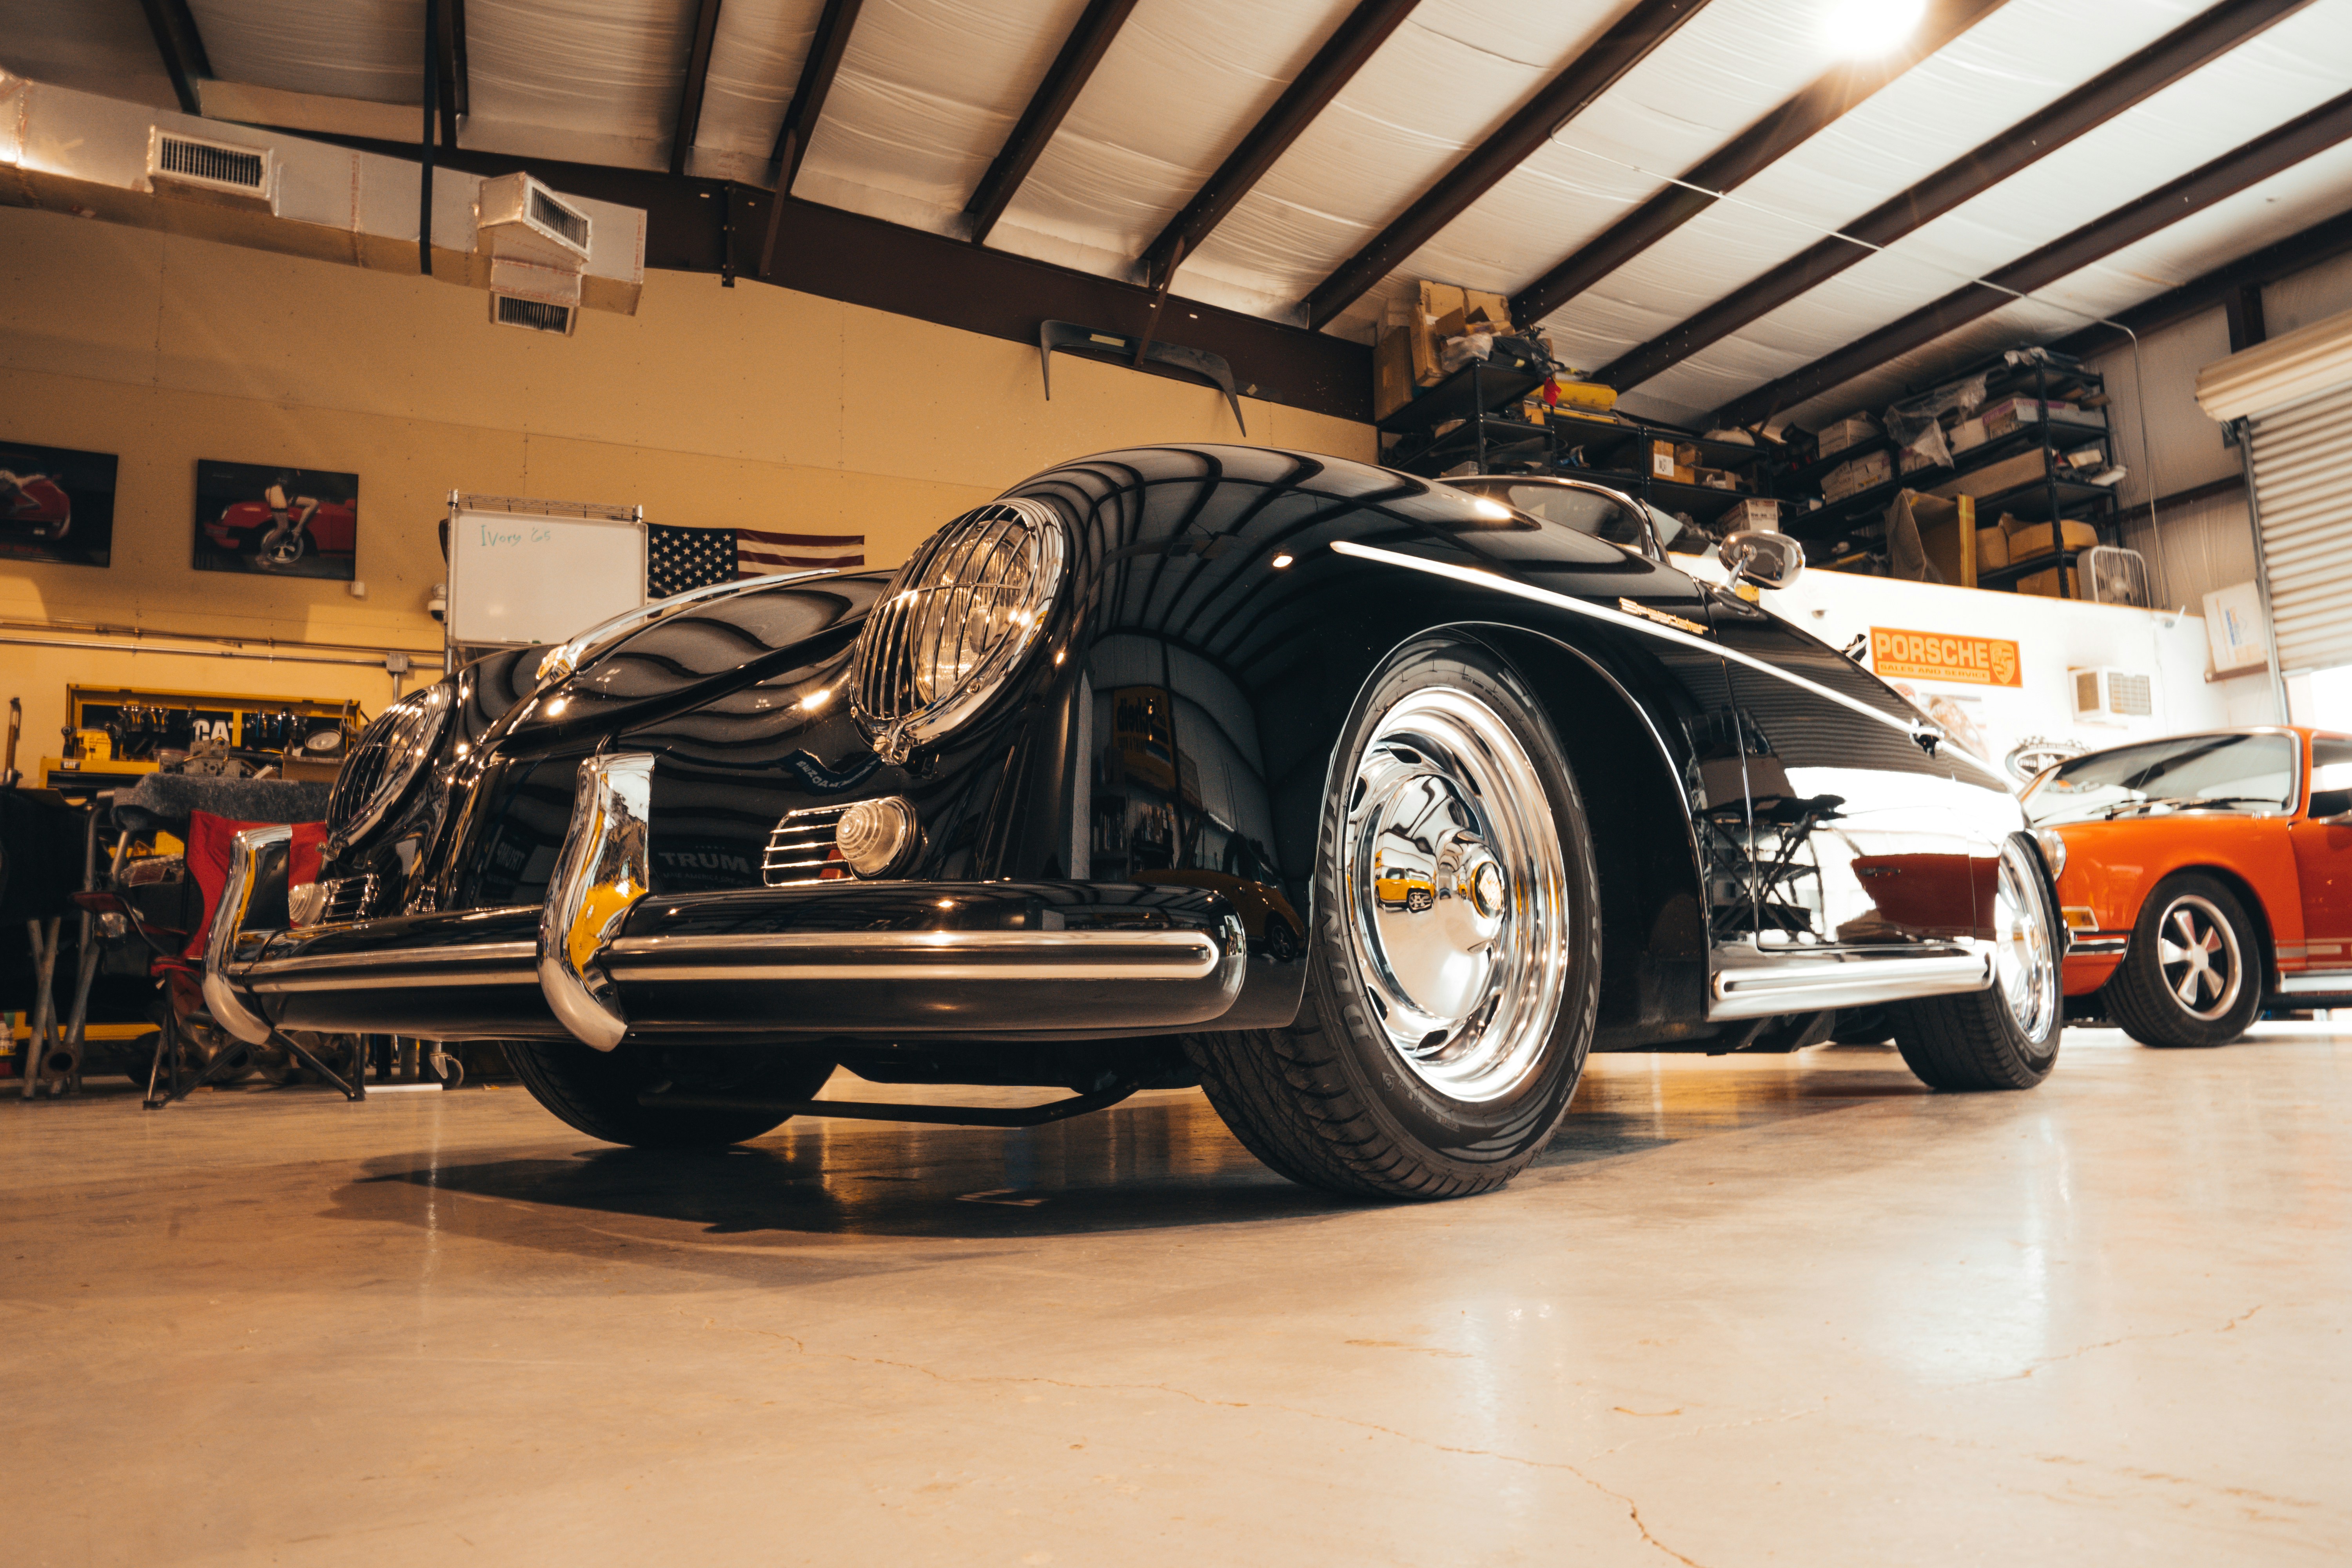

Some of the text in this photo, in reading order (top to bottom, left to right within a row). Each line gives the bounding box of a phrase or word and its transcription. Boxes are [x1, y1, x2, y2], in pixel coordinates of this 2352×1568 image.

[481, 524, 521, 546] Ivory
[1875, 632, 1989, 669] PORSCHE
[1880, 664, 1914, 672] SALES
[1944, 671, 1988, 679] SERVICE
[192, 718, 244, 742] CA
[658, 852, 751, 874] TRUM
[1318, 768, 1373, 1044] DUNLOP
